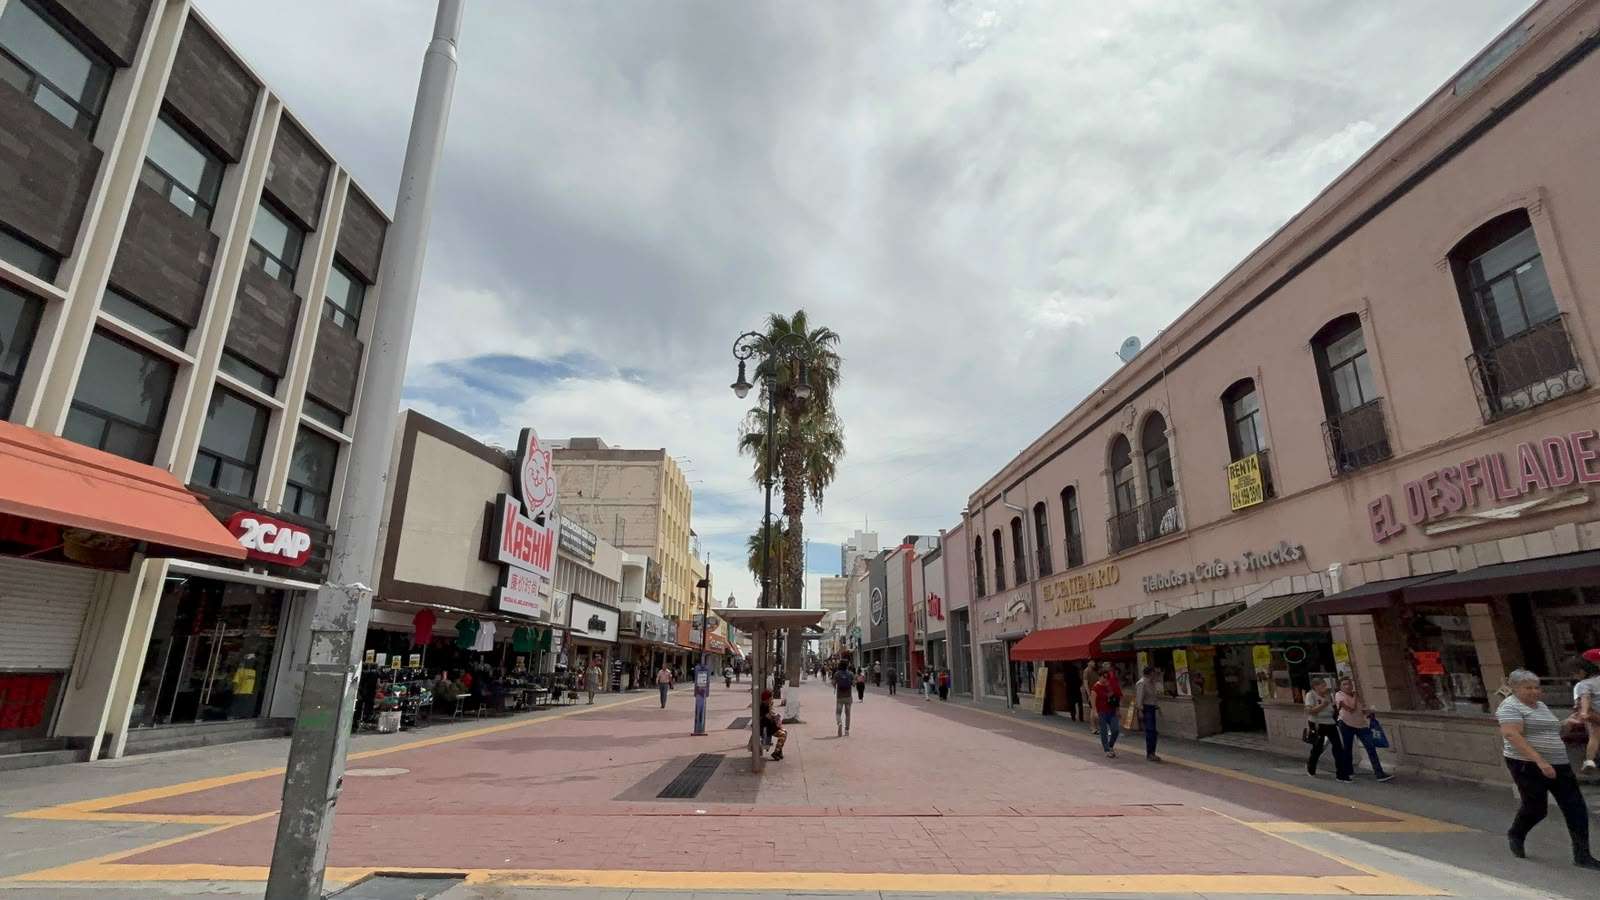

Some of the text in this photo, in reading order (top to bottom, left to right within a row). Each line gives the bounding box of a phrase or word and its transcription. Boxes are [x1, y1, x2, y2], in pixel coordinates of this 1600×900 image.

[1229, 457, 1257, 480] RENTA
[1368, 430, 1600, 543] EL DESFILADE
[239, 518, 311, 559] 2CAP
[503, 503, 553, 572] KASHIN
[1142, 570, 1184, 593] Helados
[1241, 541, 1304, 571] Snacks
